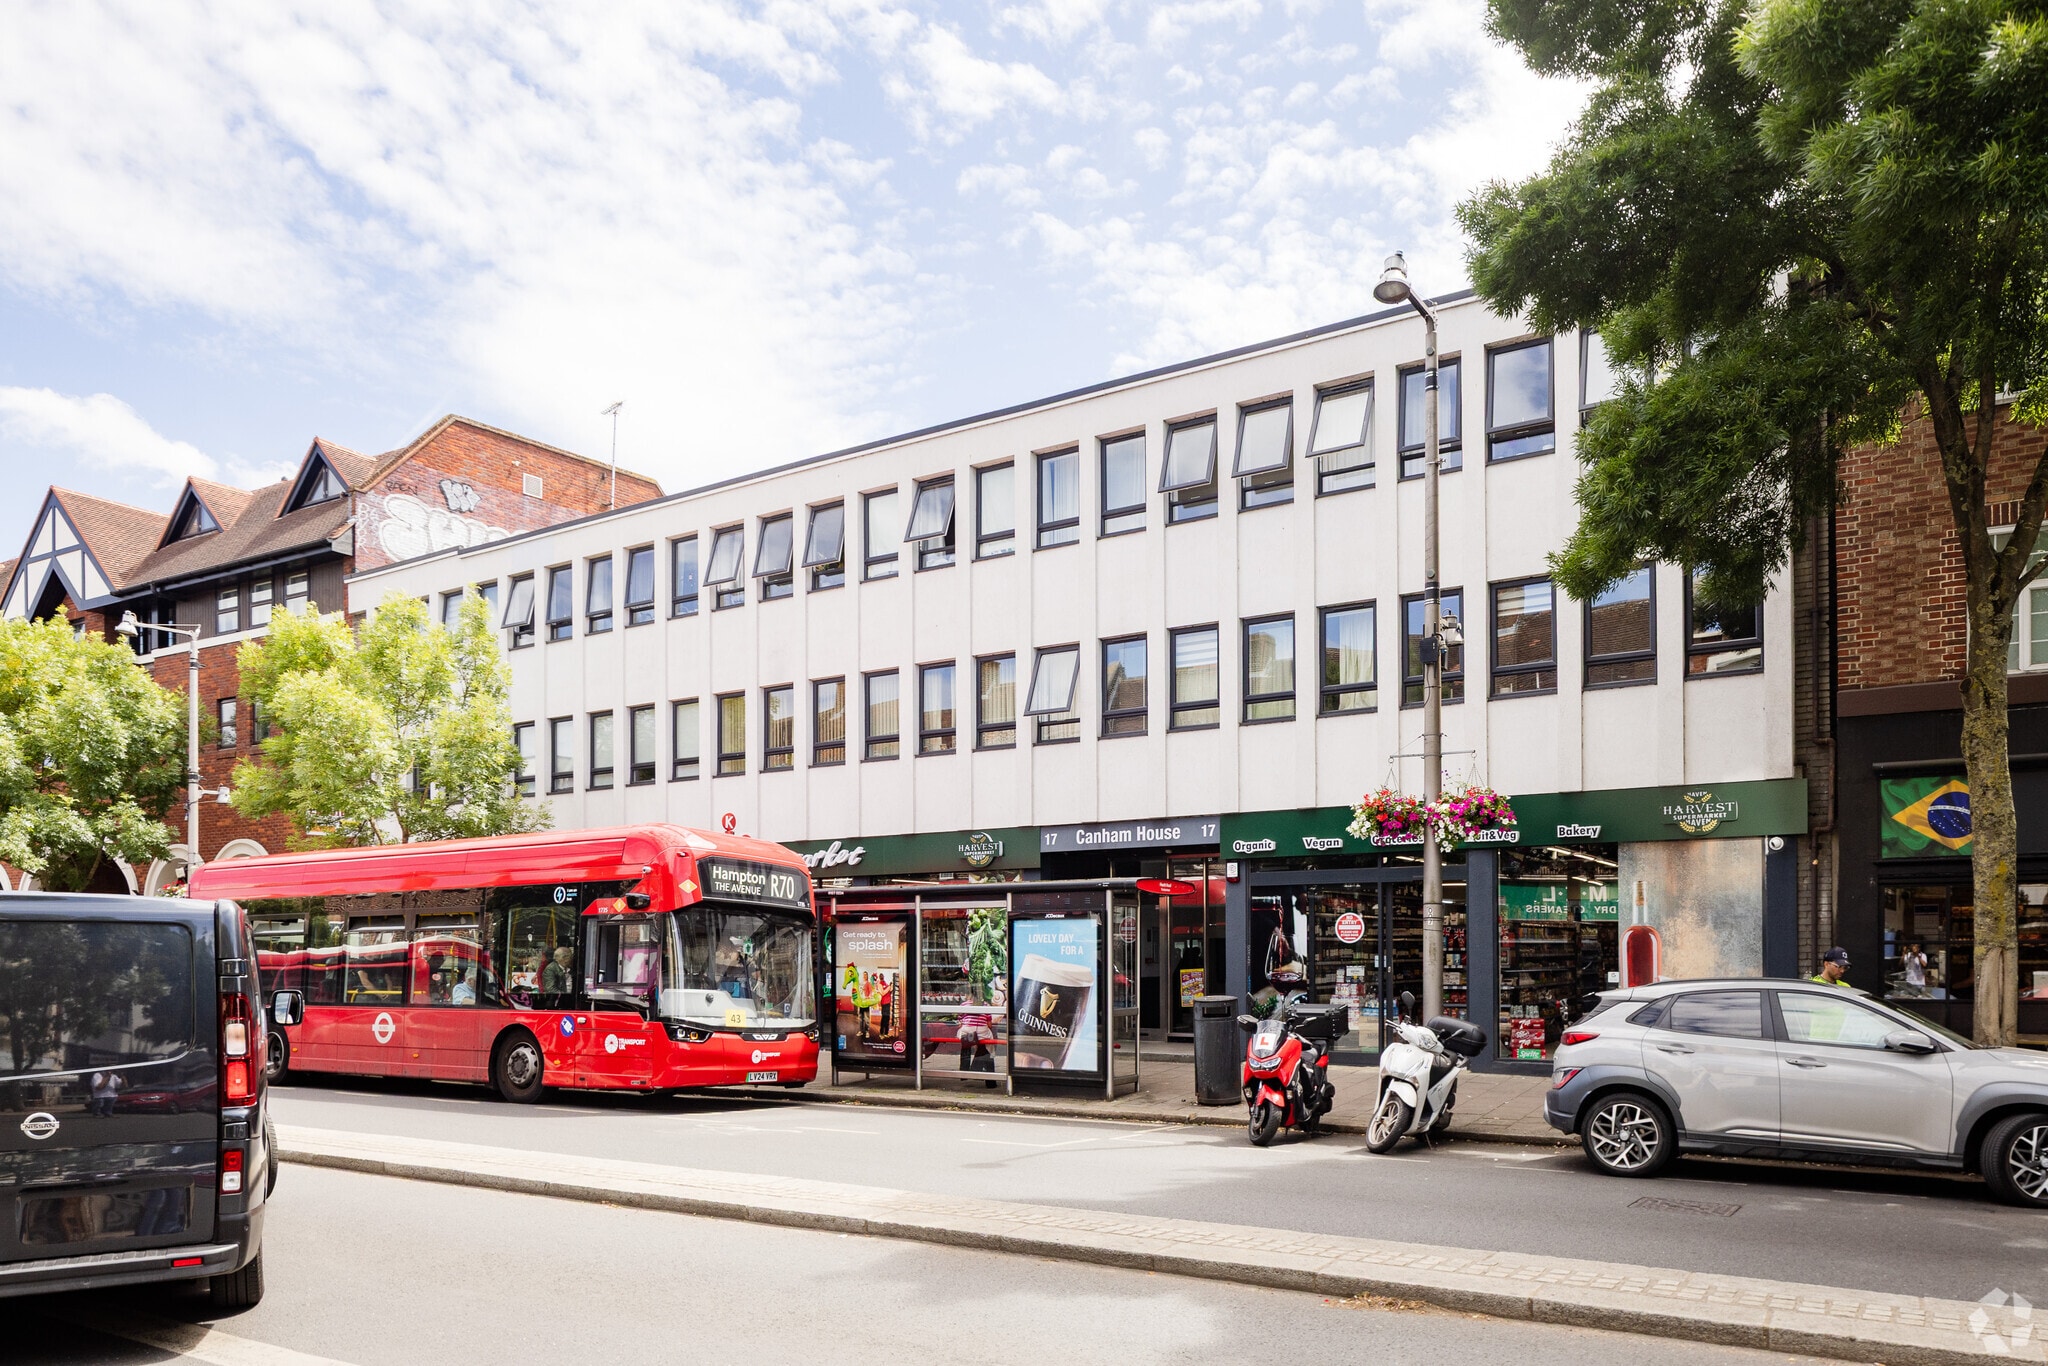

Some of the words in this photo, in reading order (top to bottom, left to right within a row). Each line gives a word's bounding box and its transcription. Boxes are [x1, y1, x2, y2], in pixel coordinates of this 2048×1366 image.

[1663, 801, 1735, 815] HARVEST
[725, 815, 733, 829] K
[1673, 812, 1727, 820] SUPERMARKET
[1076, 829, 1132, 844] Canham
[1136, 826, 1181, 841] House
[1201, 824, 1216, 837] 17
[1558, 826, 1599, 838] Bakery
[1044, 833, 1057, 845] 17
[1304, 837, 1341, 849] Vegan
[958, 842, 999, 852] HARVEST
[1234, 840, 1273, 853] Organic
[712, 866, 766, 885] Hampton
[714, 881, 730, 892] THE
[732, 884, 761, 895] AVENUE
[770, 874, 795, 899] R70
[856, 931, 876, 939] ready
[1028, 934, 1057, 944] LOVELY
[1058, 933, 1074, 943] DAY
[848, 938, 893, 952] splash
[1060, 945, 1077, 955] FOR
[1077, 945, 1084, 955] A
[730, 1013, 742, 1024] 43
[1018, 1007, 1067, 1038] GUINNESS
[1260, 1036, 1269, 1046] L
[749, 1073, 765, 1081] LV24
[765, 1072, 777, 1080] VRX
